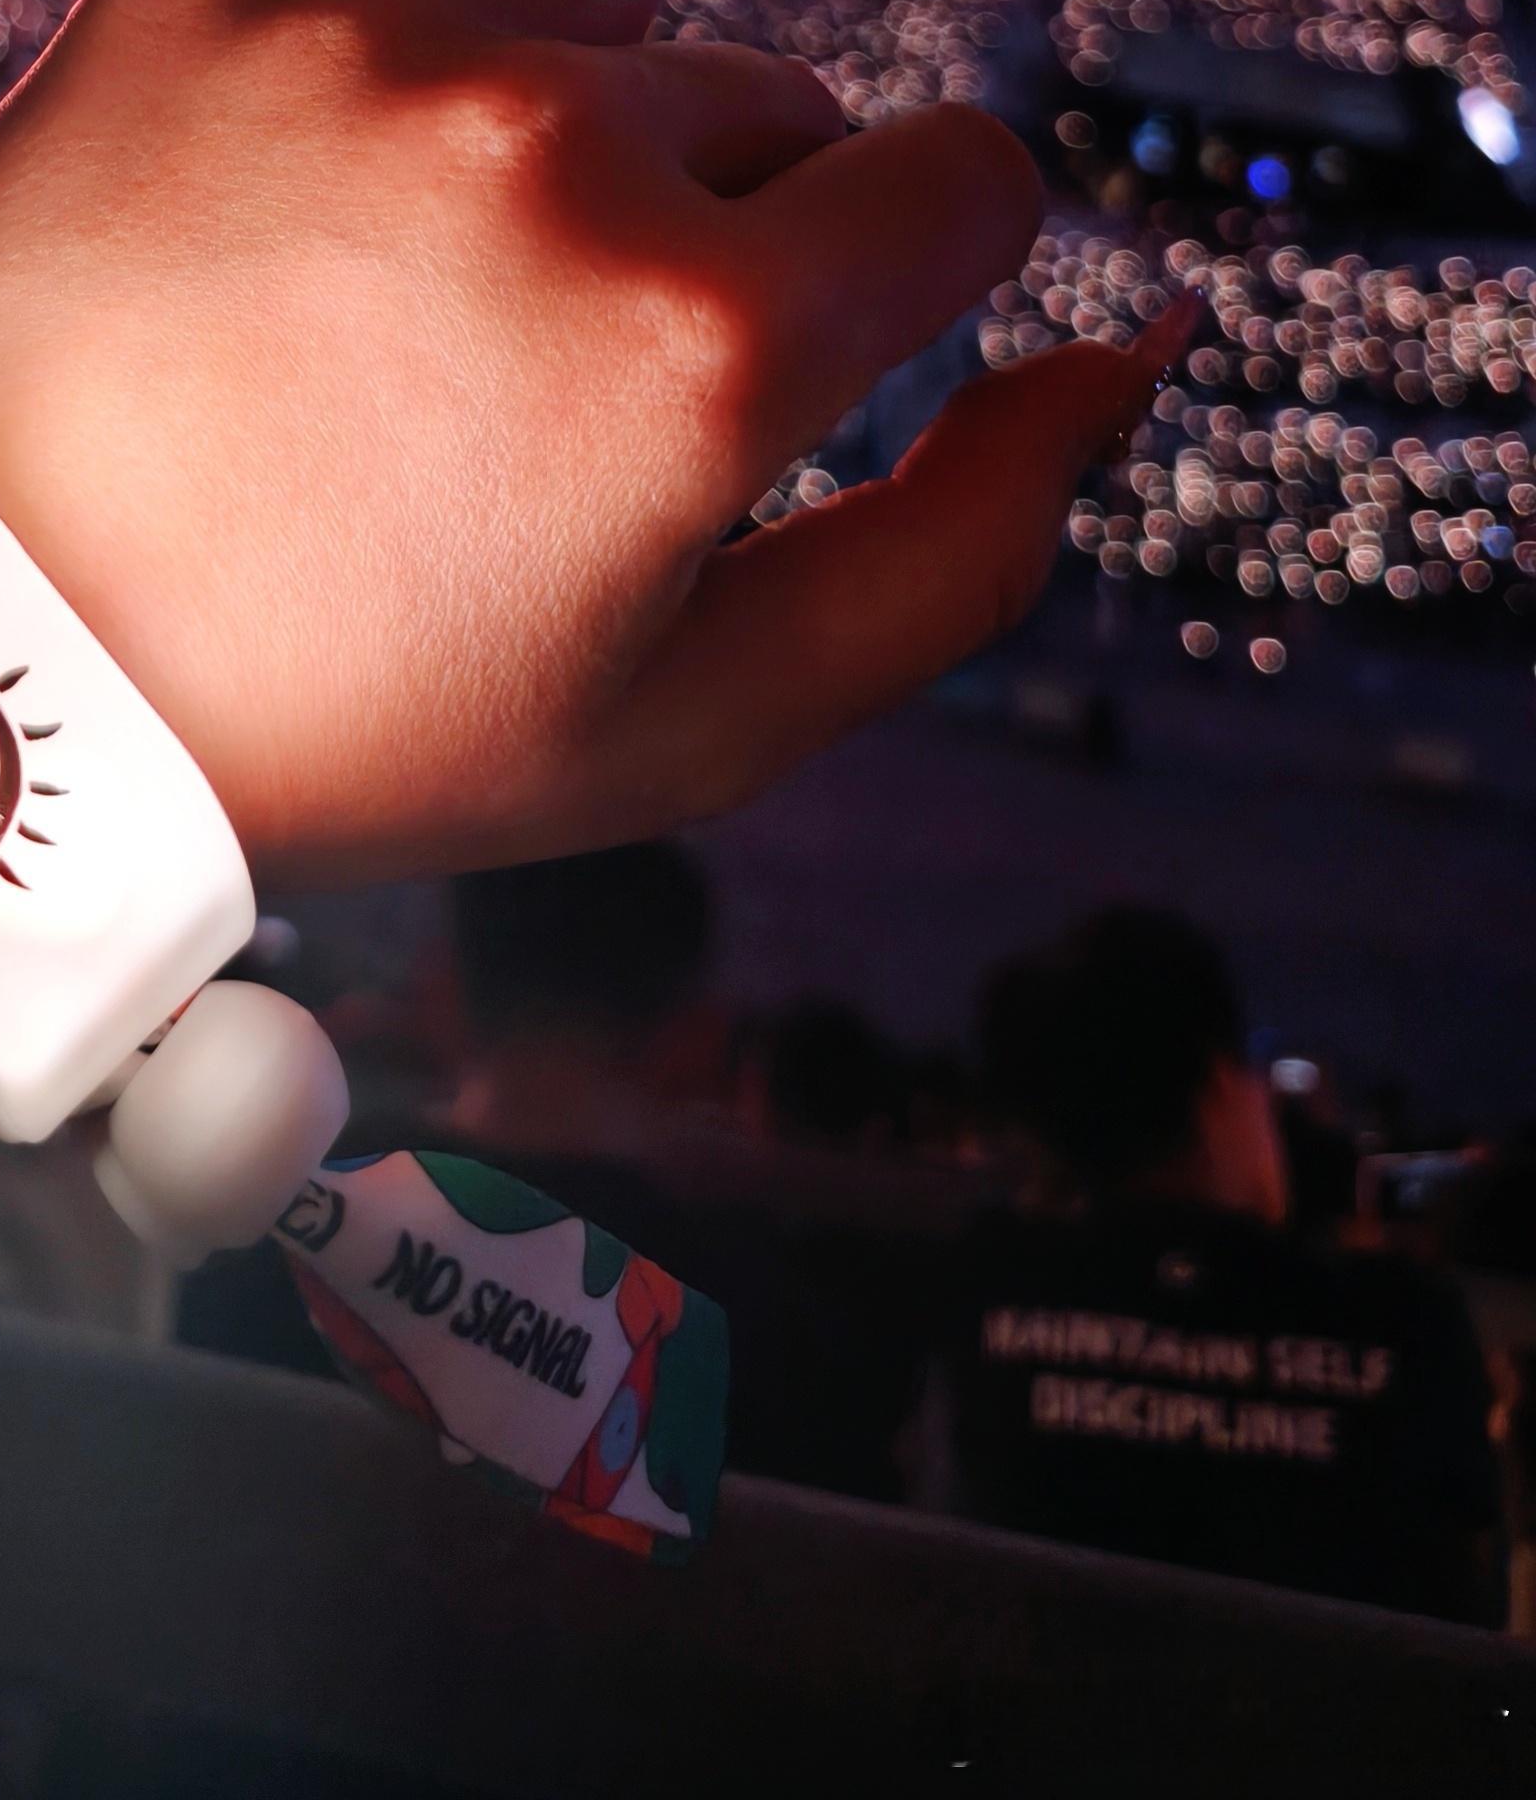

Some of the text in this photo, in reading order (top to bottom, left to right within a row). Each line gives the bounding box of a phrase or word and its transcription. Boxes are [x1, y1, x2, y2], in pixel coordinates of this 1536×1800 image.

[374, 1230, 593, 1399] NO SIGNAL
[1267, 1335, 1395, 1397] SELF
[1030, 1372, 1337, 1460] DISCIPLINE
